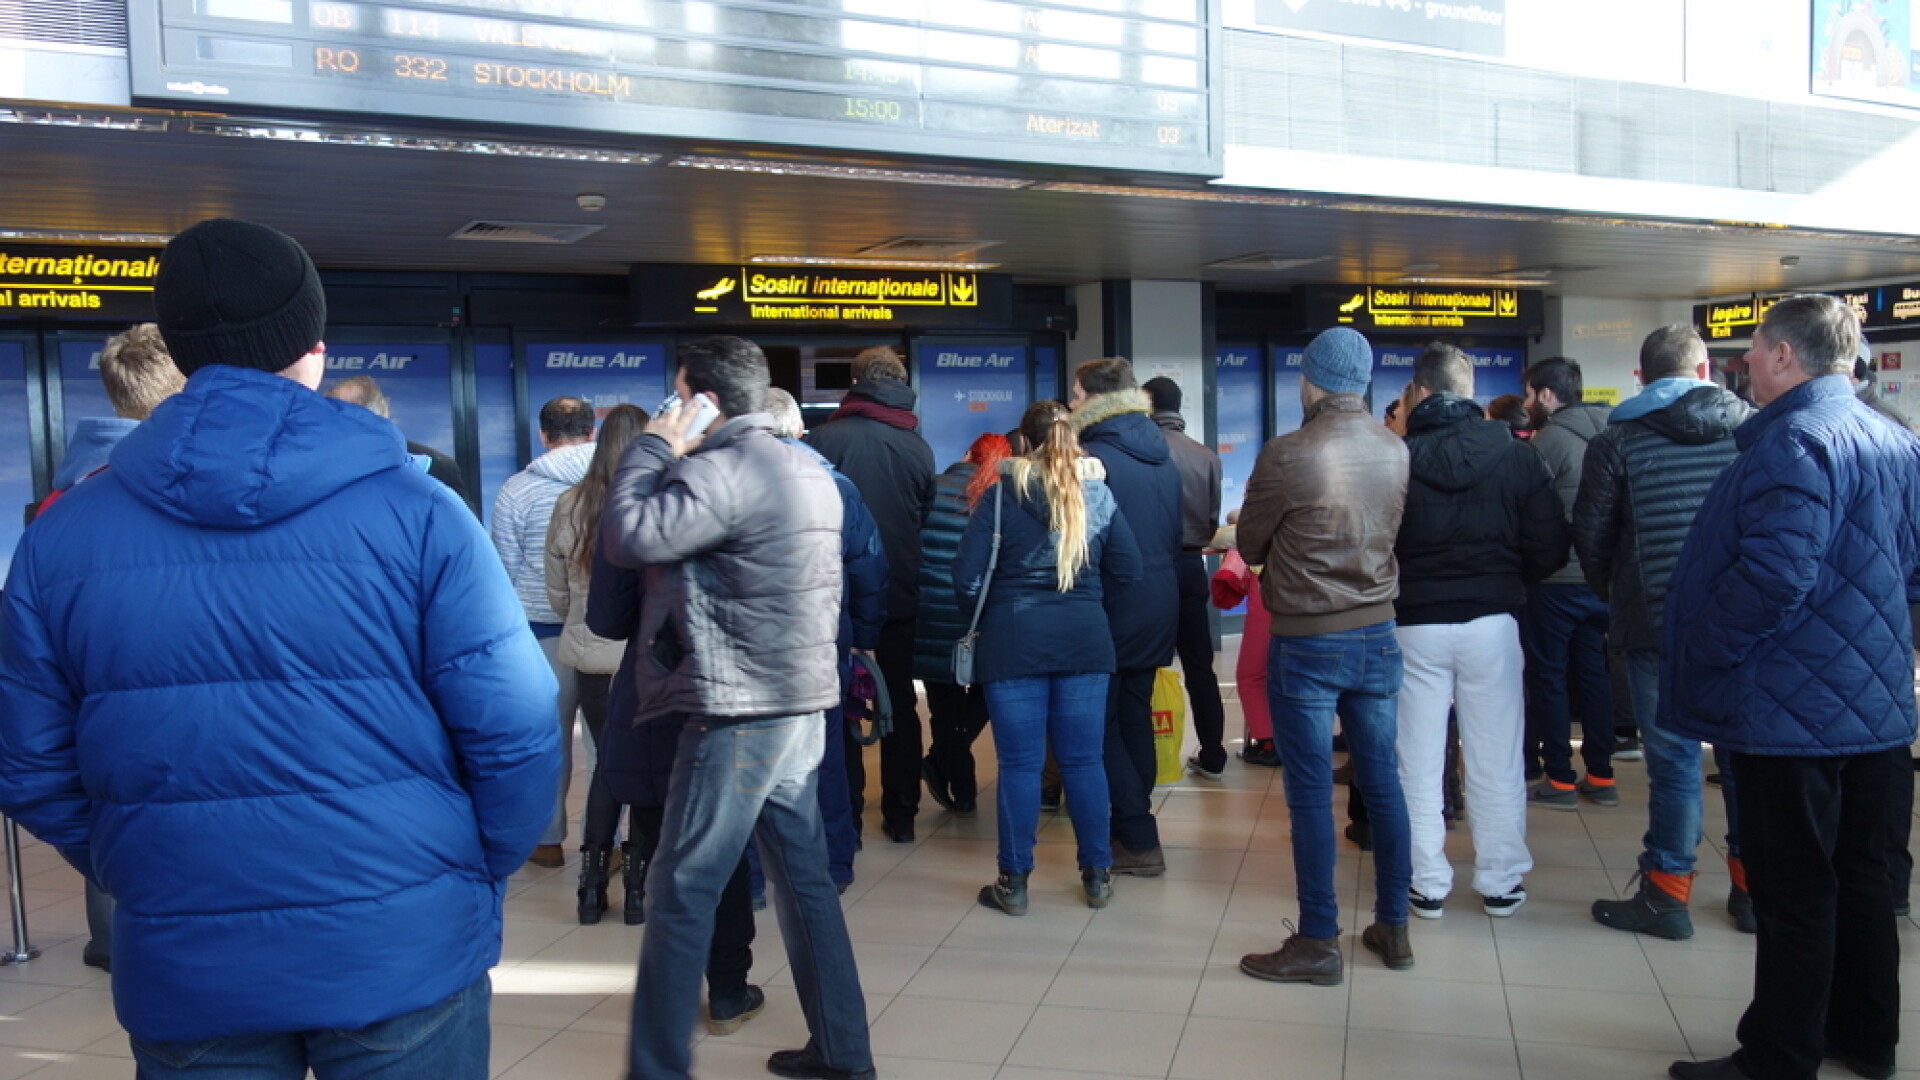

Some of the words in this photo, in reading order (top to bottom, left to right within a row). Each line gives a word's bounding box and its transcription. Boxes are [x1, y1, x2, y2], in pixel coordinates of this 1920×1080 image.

[1425, 2, 1504, 25] groundfloor
[390, 12, 440, 38] 114
[315, 48, 360, 72] RO
[393, 55, 447, 81] 332
[473, 62, 631, 97] STOCKHOLM
[844, 98, 901, 120] 15:00
[1026, 113, 1100, 138] Aterizat
[1157, 126, 1180, 144] 03
[750, 274, 808, 295] Sosiri
[18, 290, 101, 308] arrivals
[1374, 289, 1410, 306] Sosiri
[751, 304, 839, 319] International
[842, 307, 893, 320] arrivals
[1374, 313, 1430, 327] International
[1431, 315, 1464, 327] arrivals
[367, 353, 412, 369] Air
[546, 351, 605, 368] Blue
[608, 352, 647, 367] Air
[936, 352, 982, 368] Blue
[985, 353, 1015, 367] Air
[1223, 353, 1248, 366] Air
[1492, 355, 1513, 366] Air
